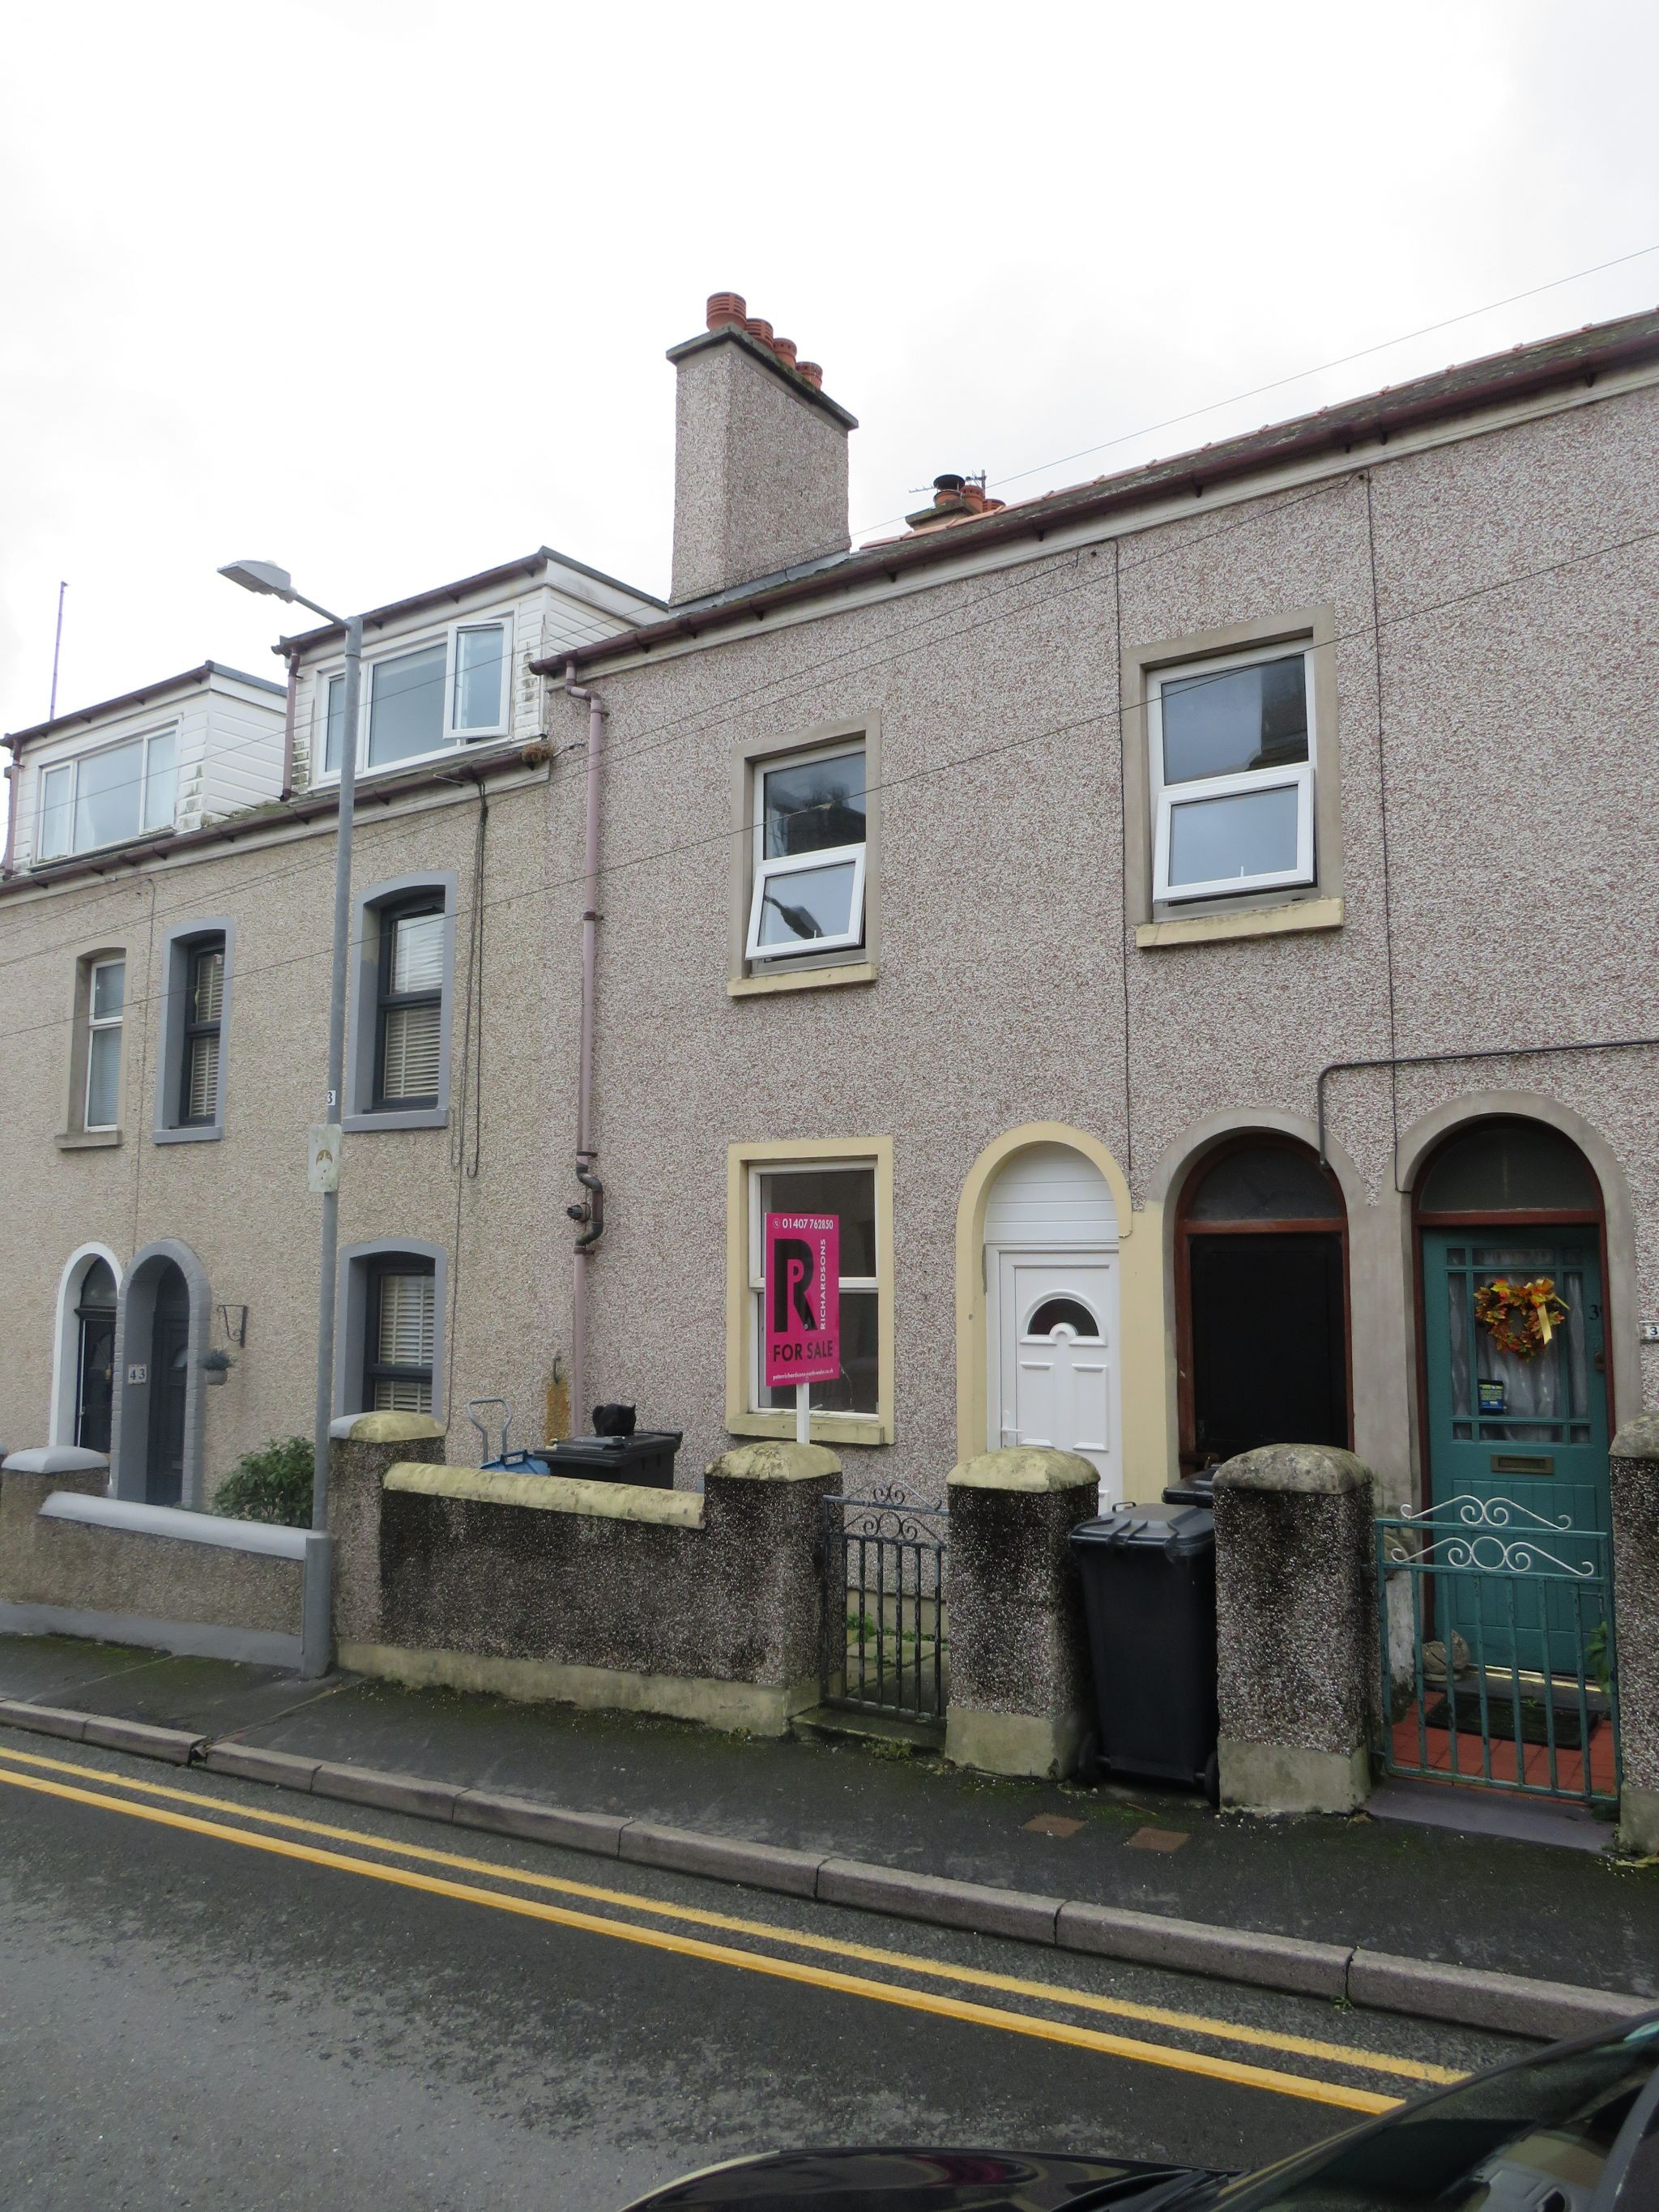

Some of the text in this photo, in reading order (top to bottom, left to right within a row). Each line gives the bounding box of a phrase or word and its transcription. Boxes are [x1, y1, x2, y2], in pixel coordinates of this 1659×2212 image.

[782, 1218, 834, 1230] 01407 762850
[773, 1340, 833, 1362] FOR SALE
[130, 1368, 146, 1380] 43
